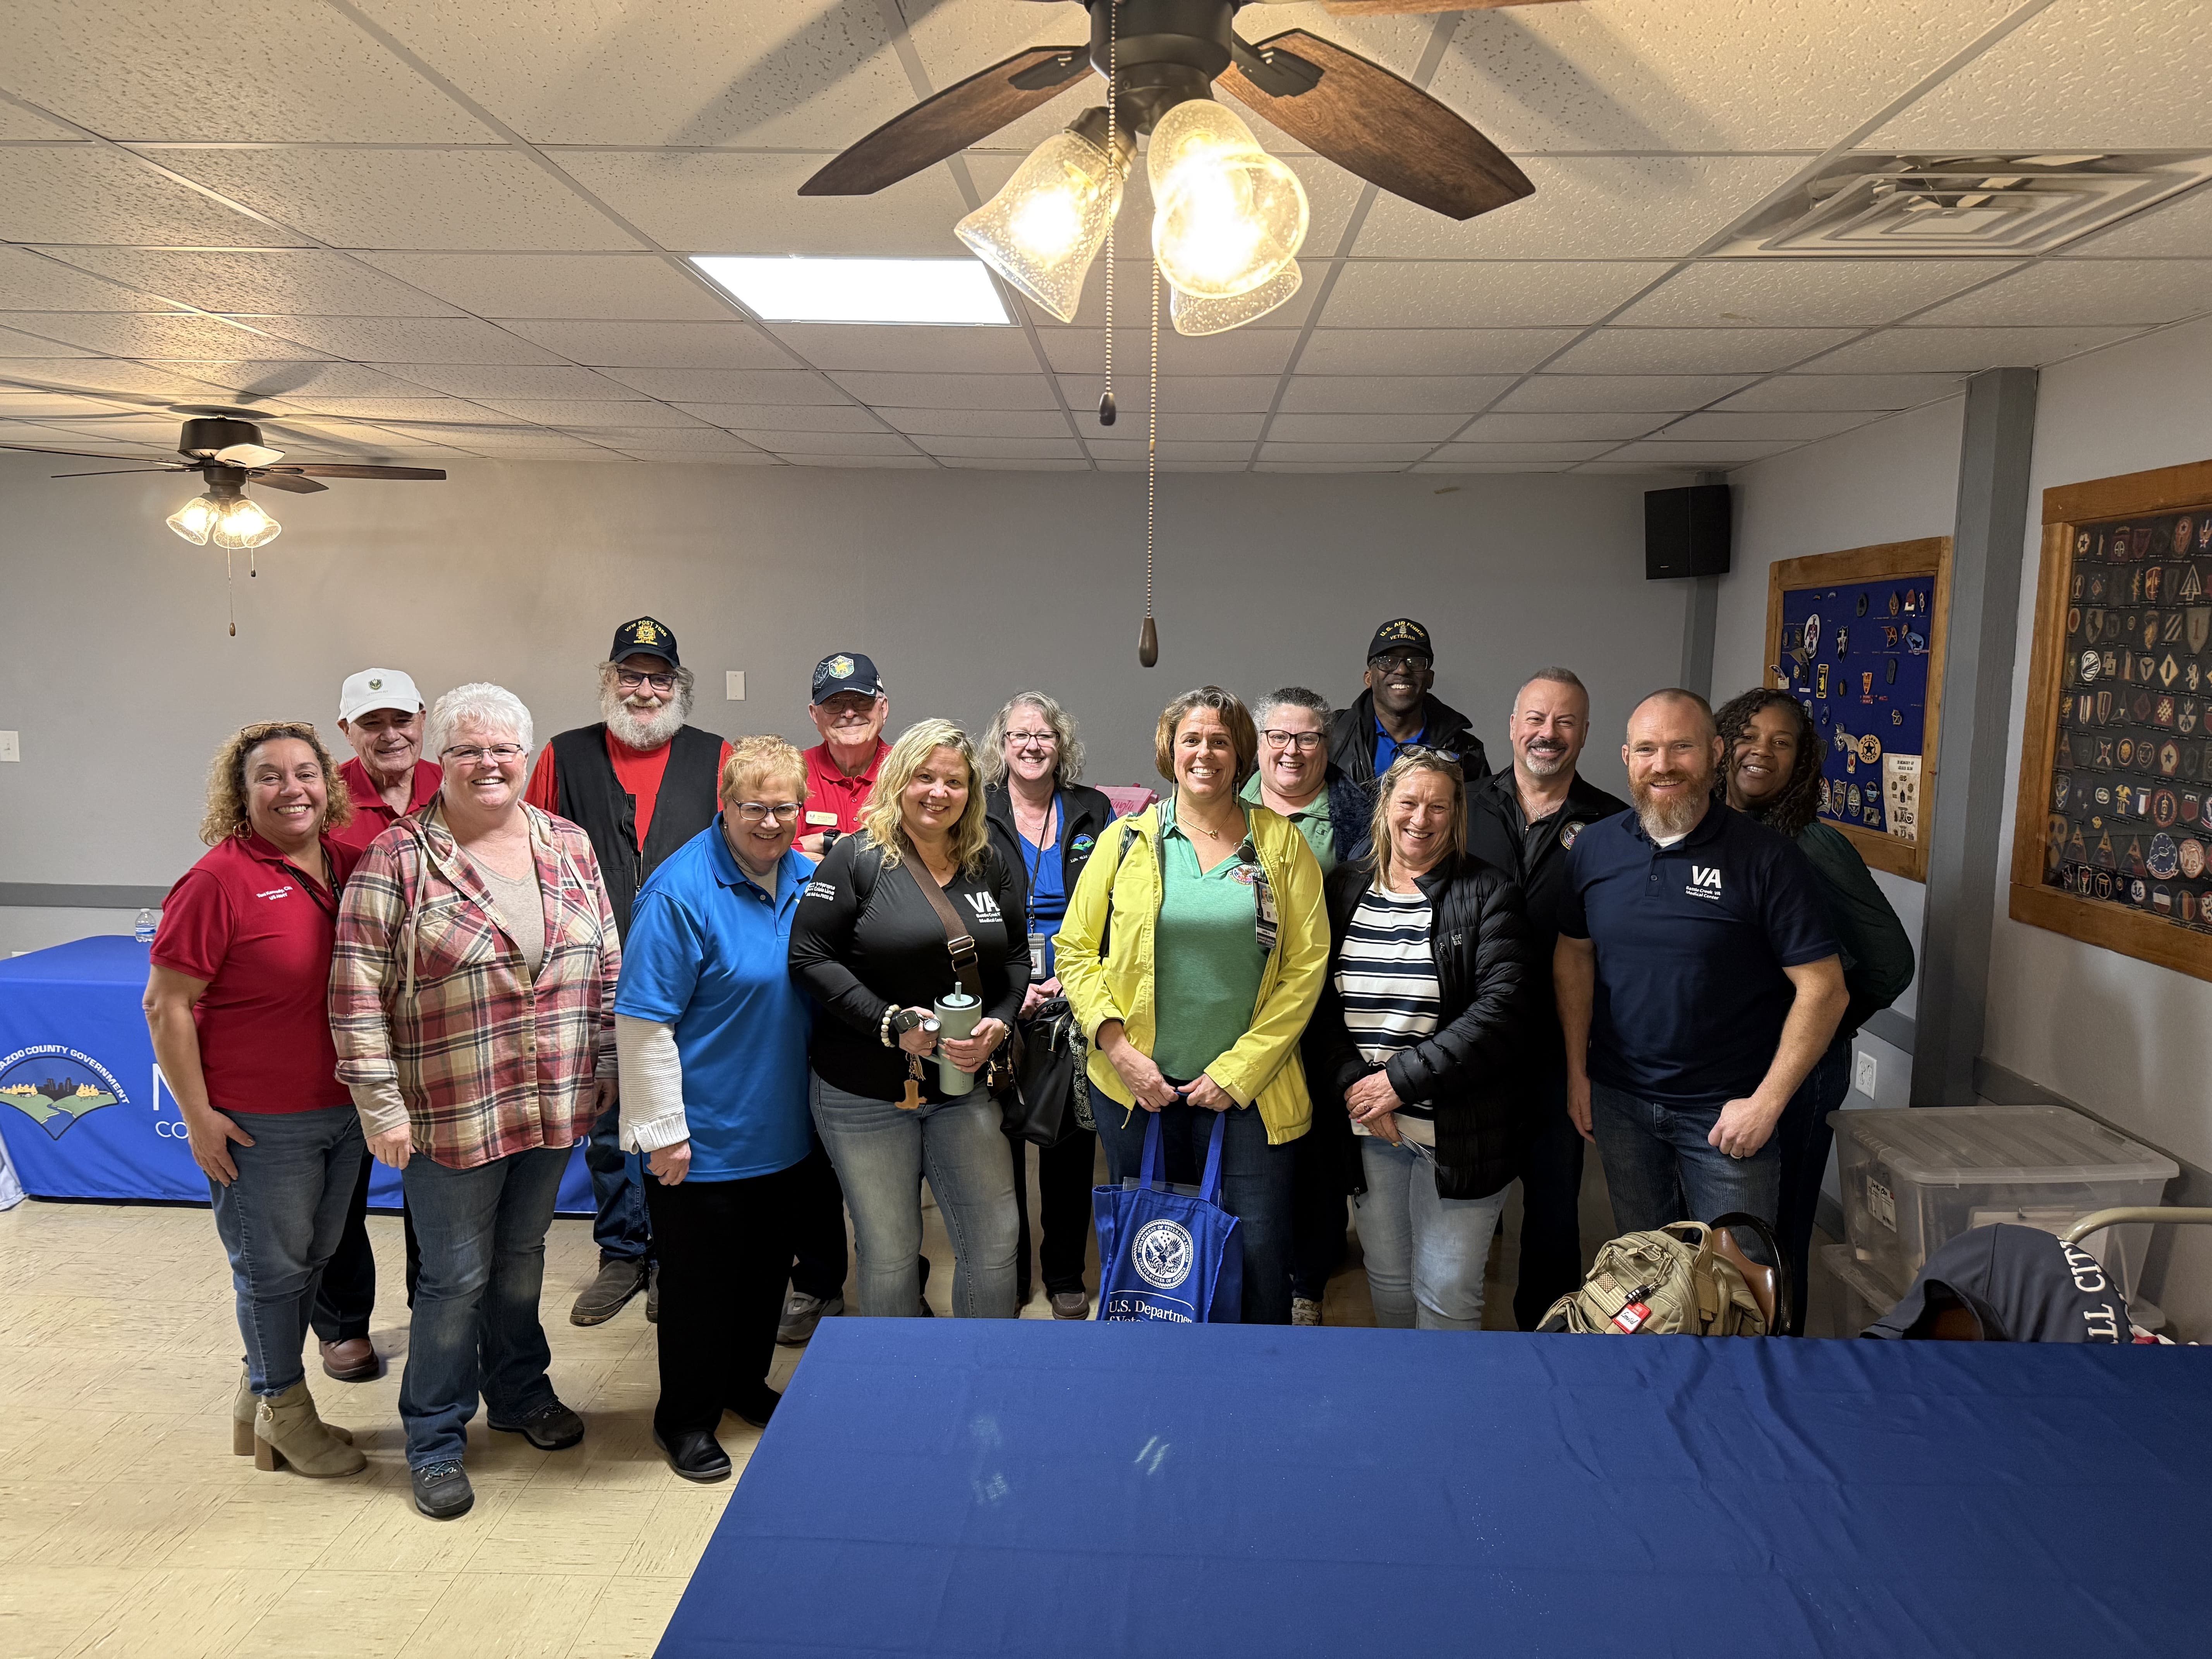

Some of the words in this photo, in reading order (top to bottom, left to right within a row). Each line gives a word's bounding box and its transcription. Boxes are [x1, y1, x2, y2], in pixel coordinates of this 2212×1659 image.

[625, 623, 636, 632] VFW
[1380, 626, 1393, 637] U.S.
[1407, 622, 1425, 637] FORCE
[1692, 866, 1721, 889] VA
[964, 891, 1001, 913] VA
[0, 1049, 25, 1073] AZOO
[25, 1044, 69, 1055] COUNTY
[70, 1049, 130, 1104] GOVERNMENT
[1137, 1226, 1157, 1253] DEPARTMENT
[1164, 1225, 1186, 1241] VETERANS
[1138, 1257, 1150, 1276] UNITED
[1149, 1274, 1165, 1283] STATES
[1173, 1267, 1186, 1282] AMERICA
[1109, 1300, 1131, 1313] U.S.
[1135, 1300, 1193, 1323] Departmen
